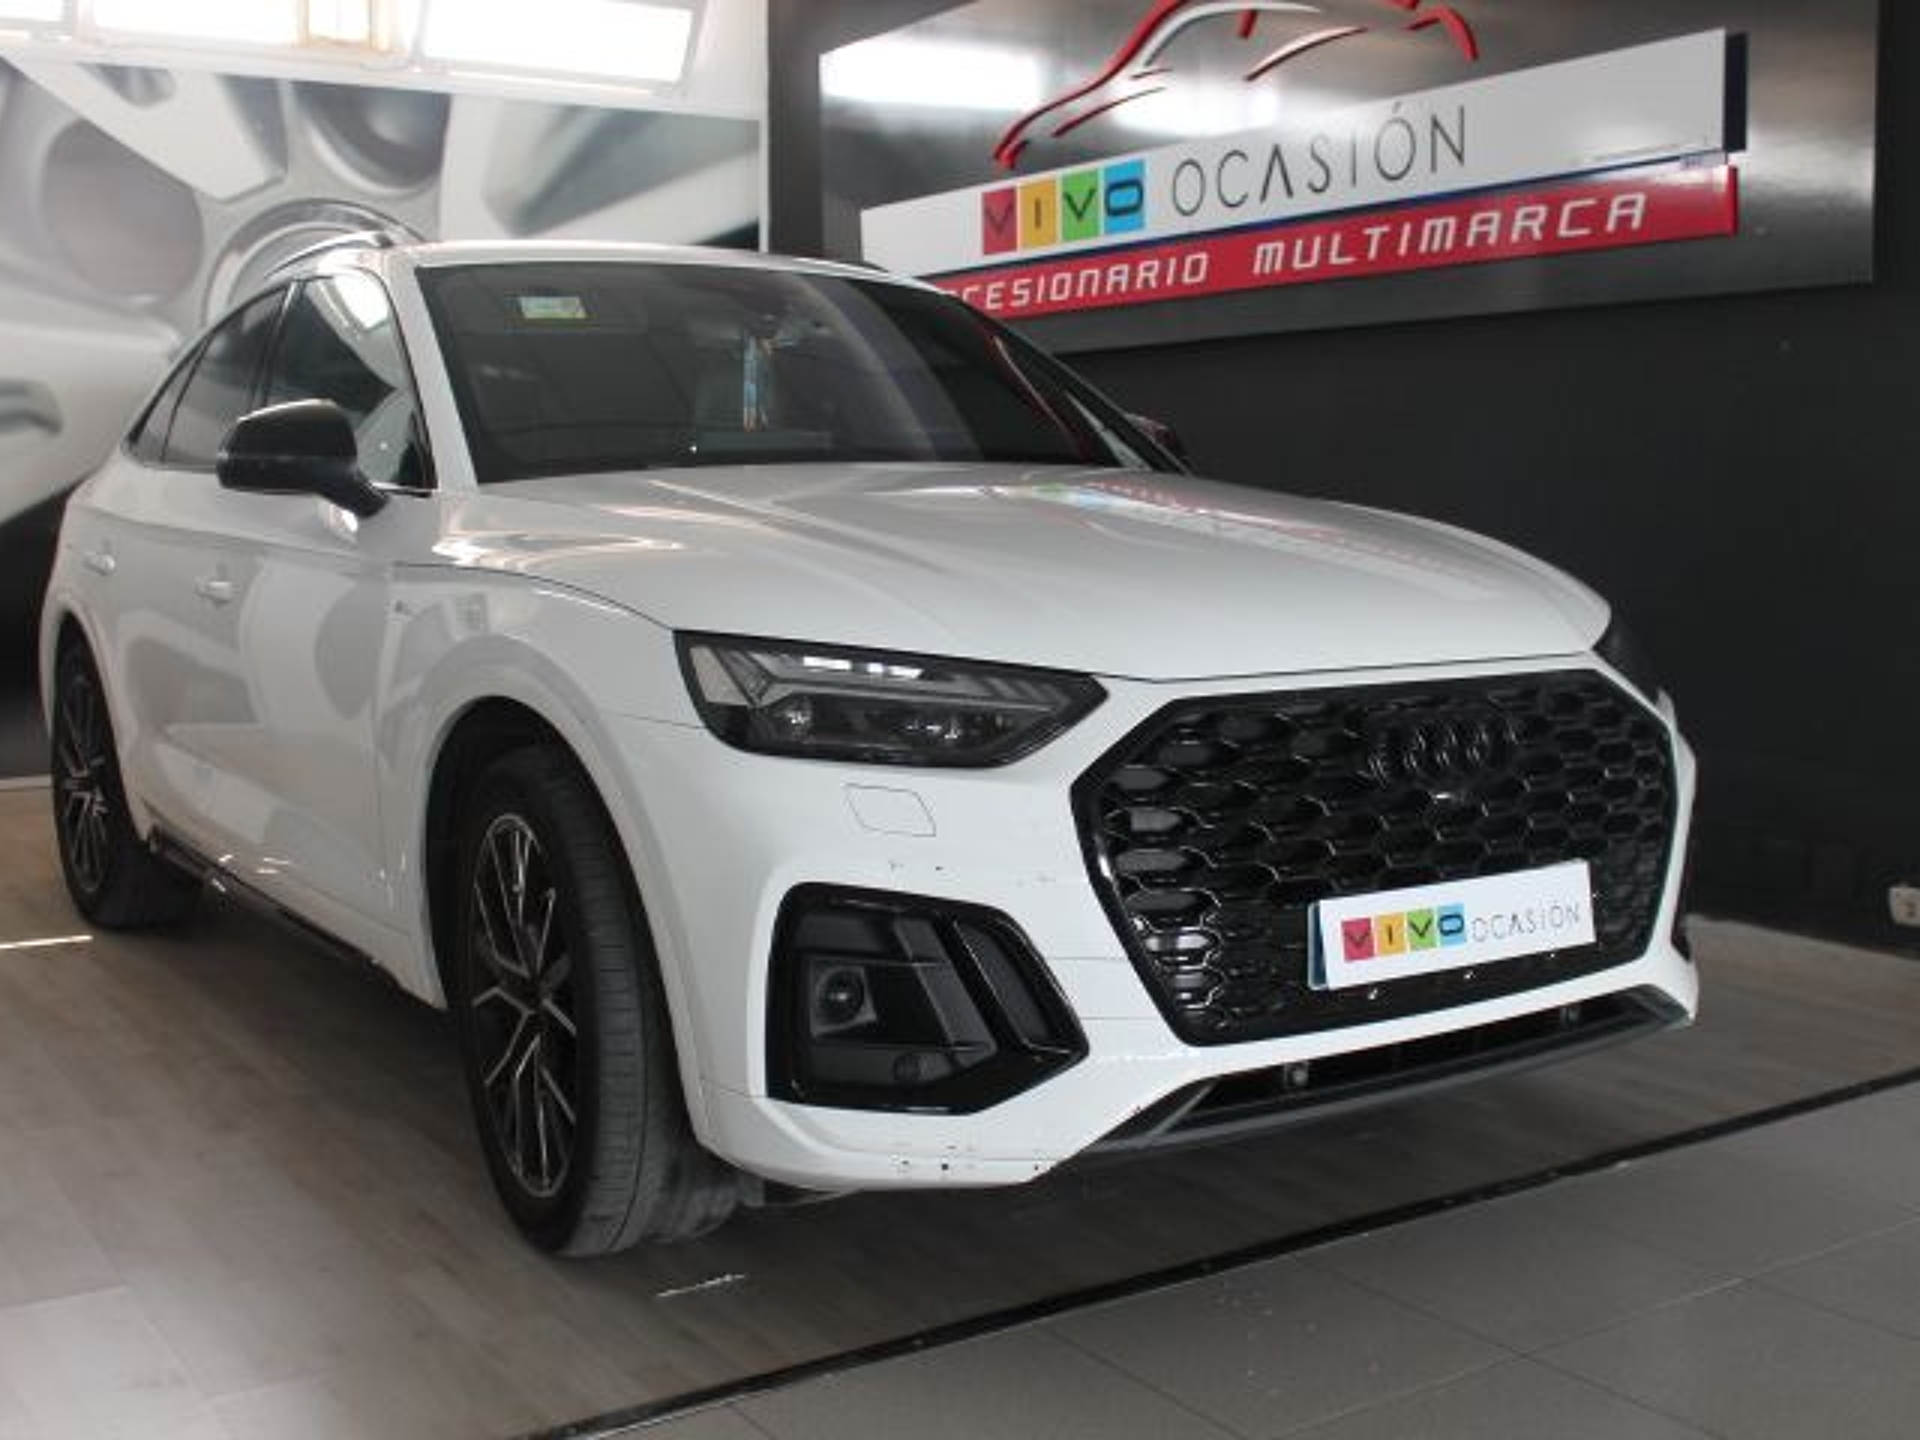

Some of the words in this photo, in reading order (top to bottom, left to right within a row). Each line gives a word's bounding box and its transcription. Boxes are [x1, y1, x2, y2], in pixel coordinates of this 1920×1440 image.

[982, 175, 1145, 236] VIVO
[1171, 101, 1466, 217] OCASIÓN
[942, 252, 1210, 310] CESIONARIO
[1253, 192, 1648, 275] MULTIMARCA
[1342, 911, 1465, 948] VIVO
[1471, 898, 1581, 943] OCASIÓN
